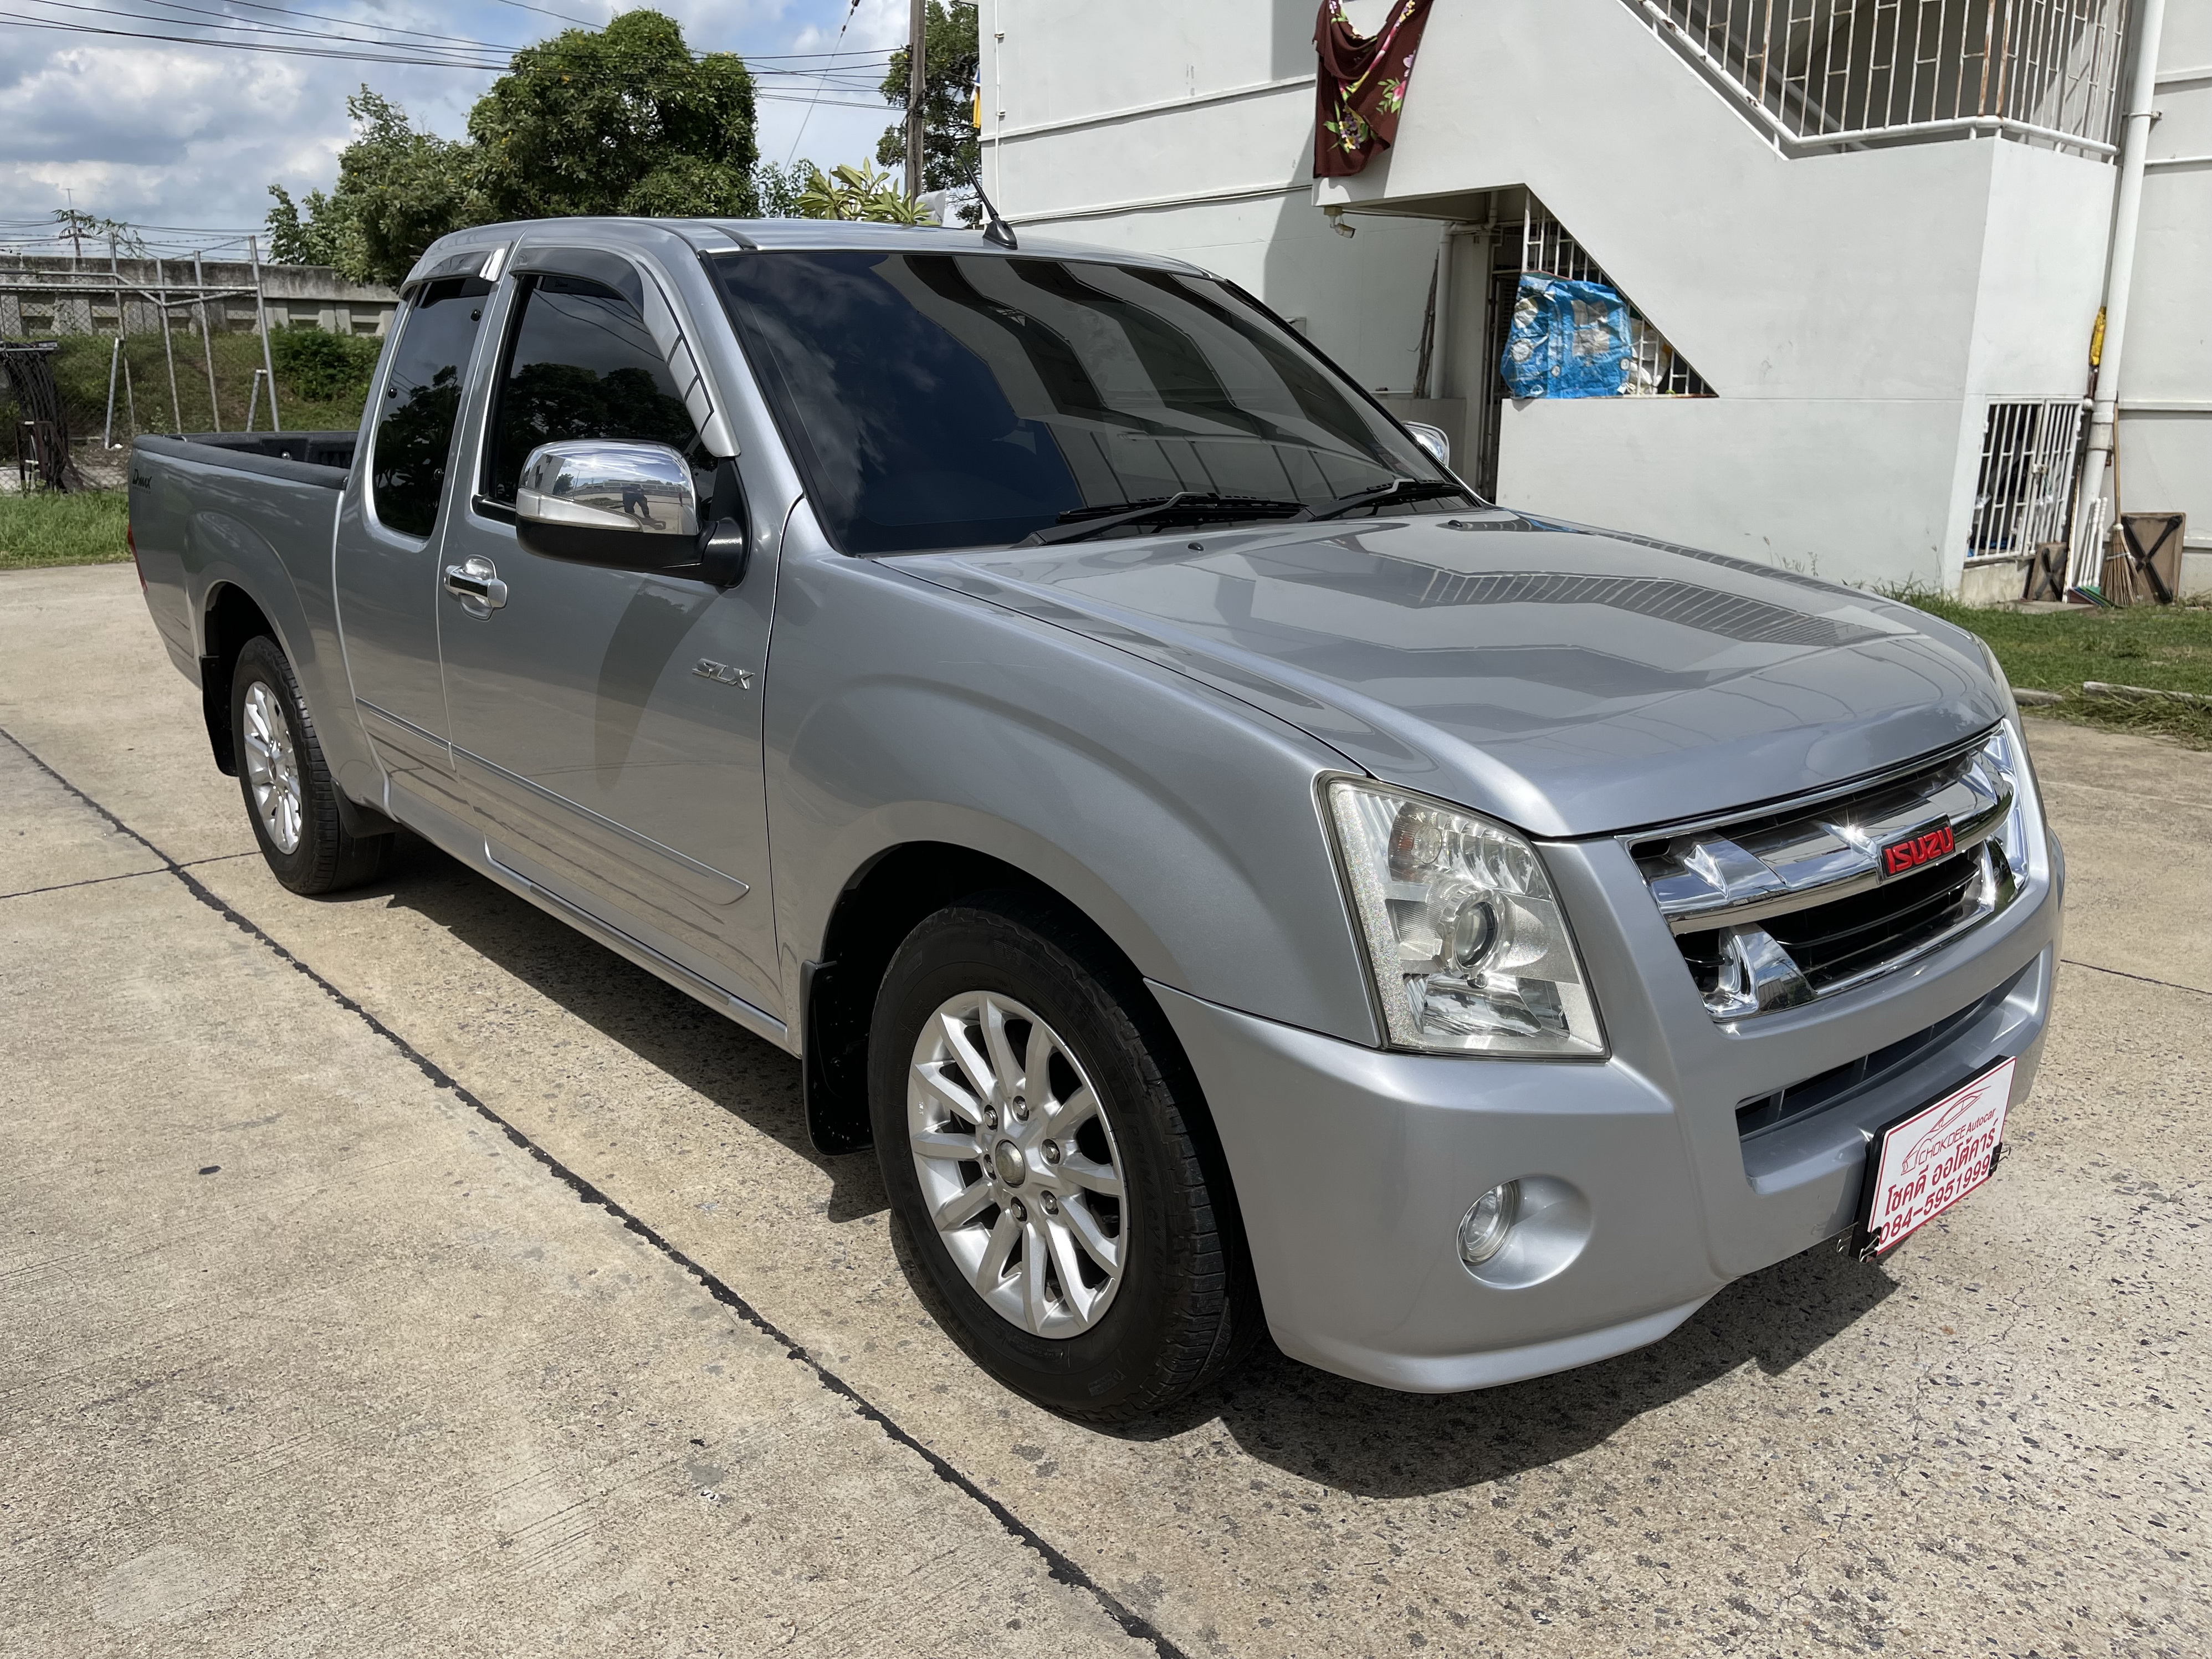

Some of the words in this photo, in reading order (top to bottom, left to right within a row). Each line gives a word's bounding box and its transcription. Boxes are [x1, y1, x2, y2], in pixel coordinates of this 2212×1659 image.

[692, 658, 755, 689] SLX
[1885, 826, 1954, 874] ISUZU
[1918, 1124, 1966, 1165] CHOKDEE
[1967, 1108, 1996, 1135] Autocar
[1885, 1164, 1929, 1216] โชคดี
[1932, 1118, 1998, 1186] ออโต้คาร์
[1879, 1154, 1990, 1245] 084-5951999
